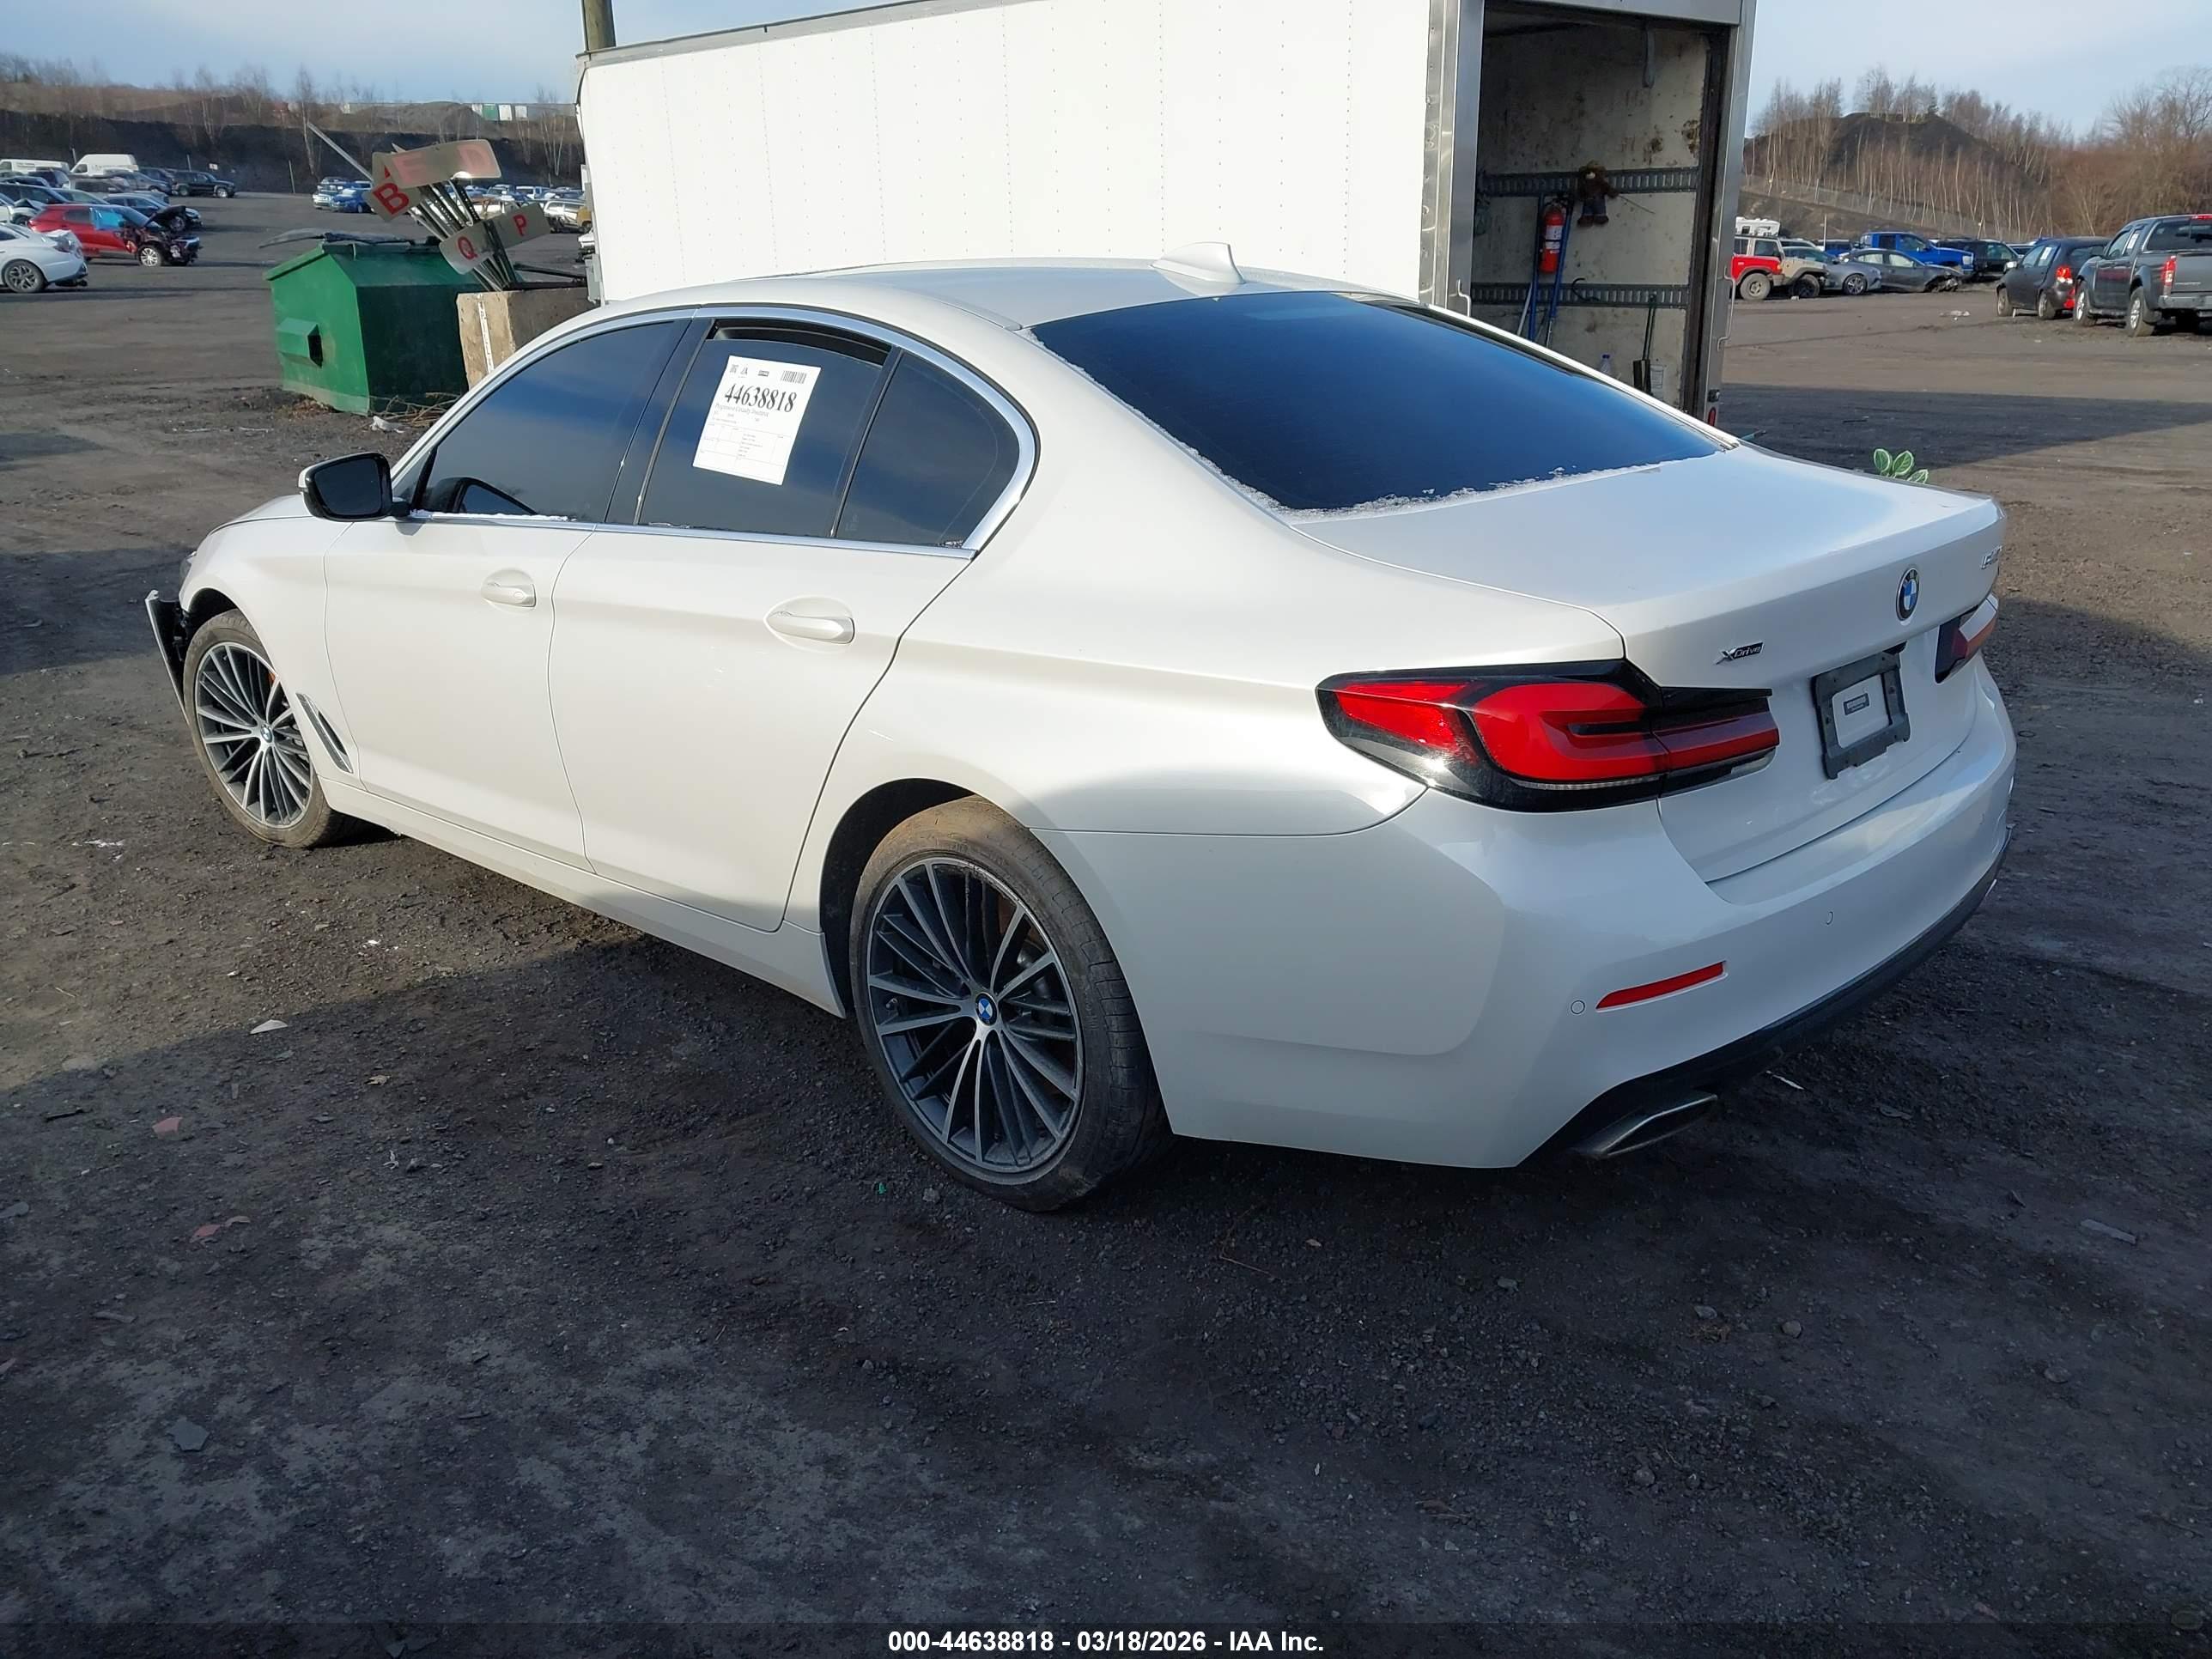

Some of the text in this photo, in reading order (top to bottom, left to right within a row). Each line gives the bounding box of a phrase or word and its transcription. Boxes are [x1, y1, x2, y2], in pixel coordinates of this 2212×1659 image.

[372, 183, 410, 215] B
[457, 214, 527, 260] Q P
[724, 382, 798, 413] 44638818
